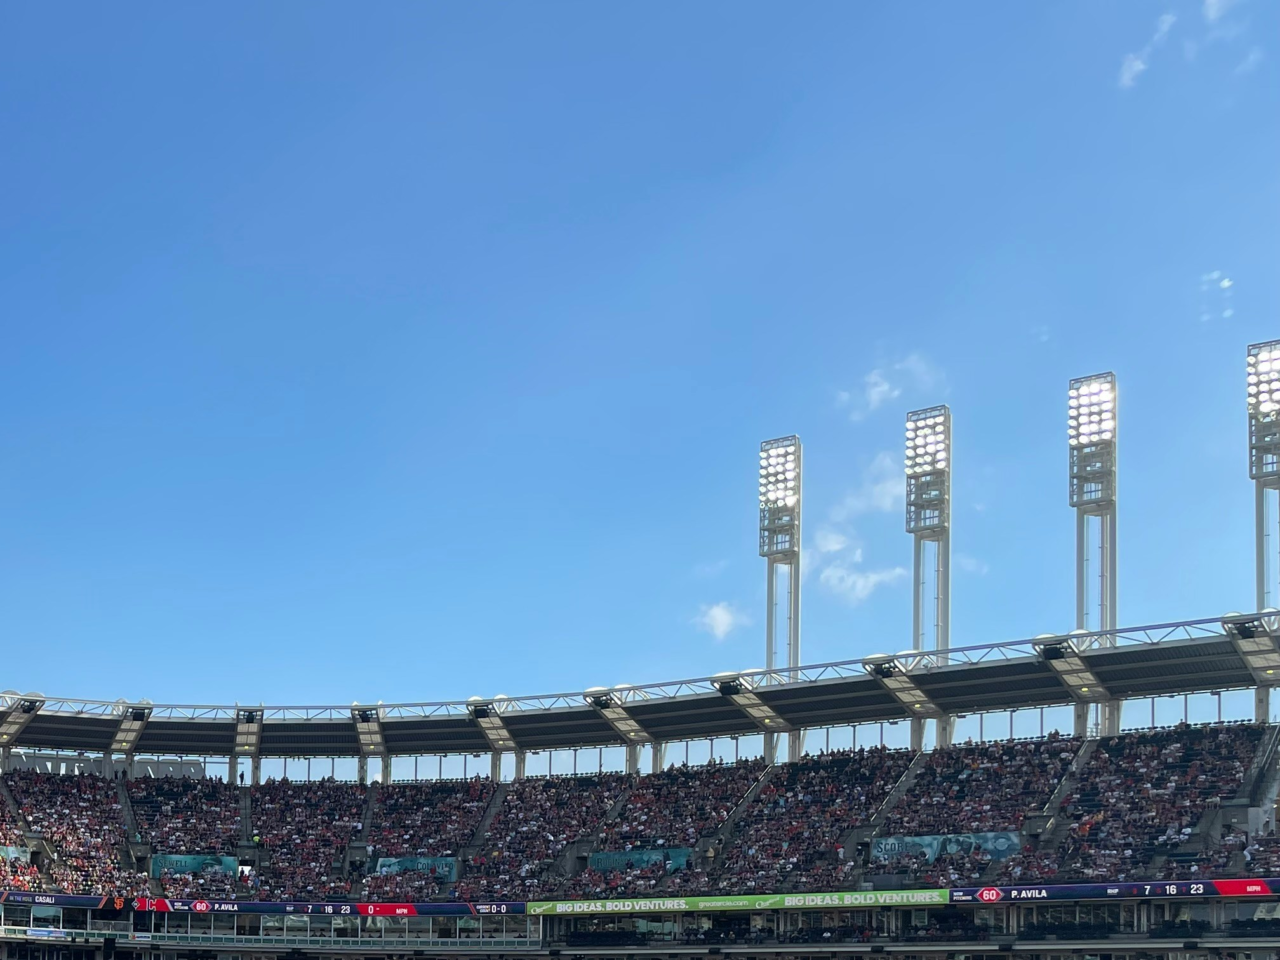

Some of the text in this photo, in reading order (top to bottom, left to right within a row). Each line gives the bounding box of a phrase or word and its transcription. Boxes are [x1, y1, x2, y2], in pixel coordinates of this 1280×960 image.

[876, 842, 911, 853] SCORE
[158, 858, 189, 868] SEWELL
[983, 890, 996, 900] 60
[1021, 889, 1047, 898] AVILA
[1144, 886, 1150, 894] 7
[1165, 885, 1177, 894] 16
[1190, 884, 1204, 894] 23
[35, 895, 54, 904] CASALI
[556, 904, 573, 912] BIG
[574, 902, 604, 912] IDEAS.
[606, 902, 632, 911] BOLD
[633, 900, 689, 910] VENTURES.
[784, 897, 805, 906] BIG
[806, 895, 842, 905] IDEAS.
[844, 894, 876, 904] BOLD
[877, 892, 943, 903] VENTURES.
